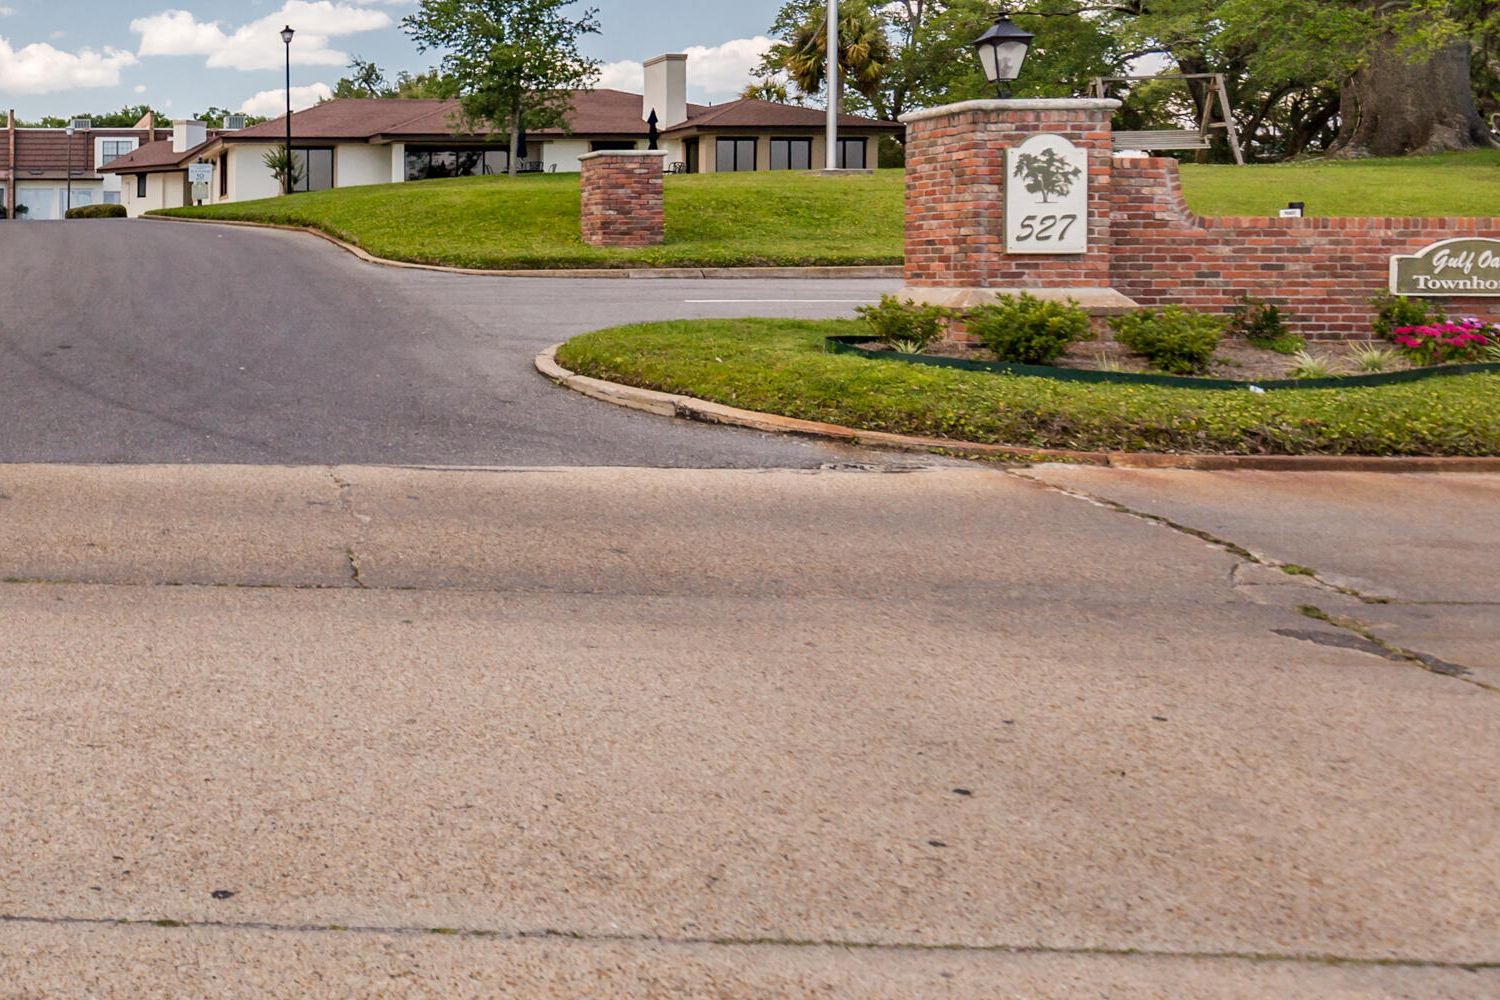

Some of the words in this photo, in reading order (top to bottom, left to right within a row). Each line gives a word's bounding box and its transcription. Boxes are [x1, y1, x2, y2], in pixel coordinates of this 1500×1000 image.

[1015, 214, 1077, 242] 527
[1432, 248, 1475, 274] Gulf
[1412, 274, 1500, 290] Townho
